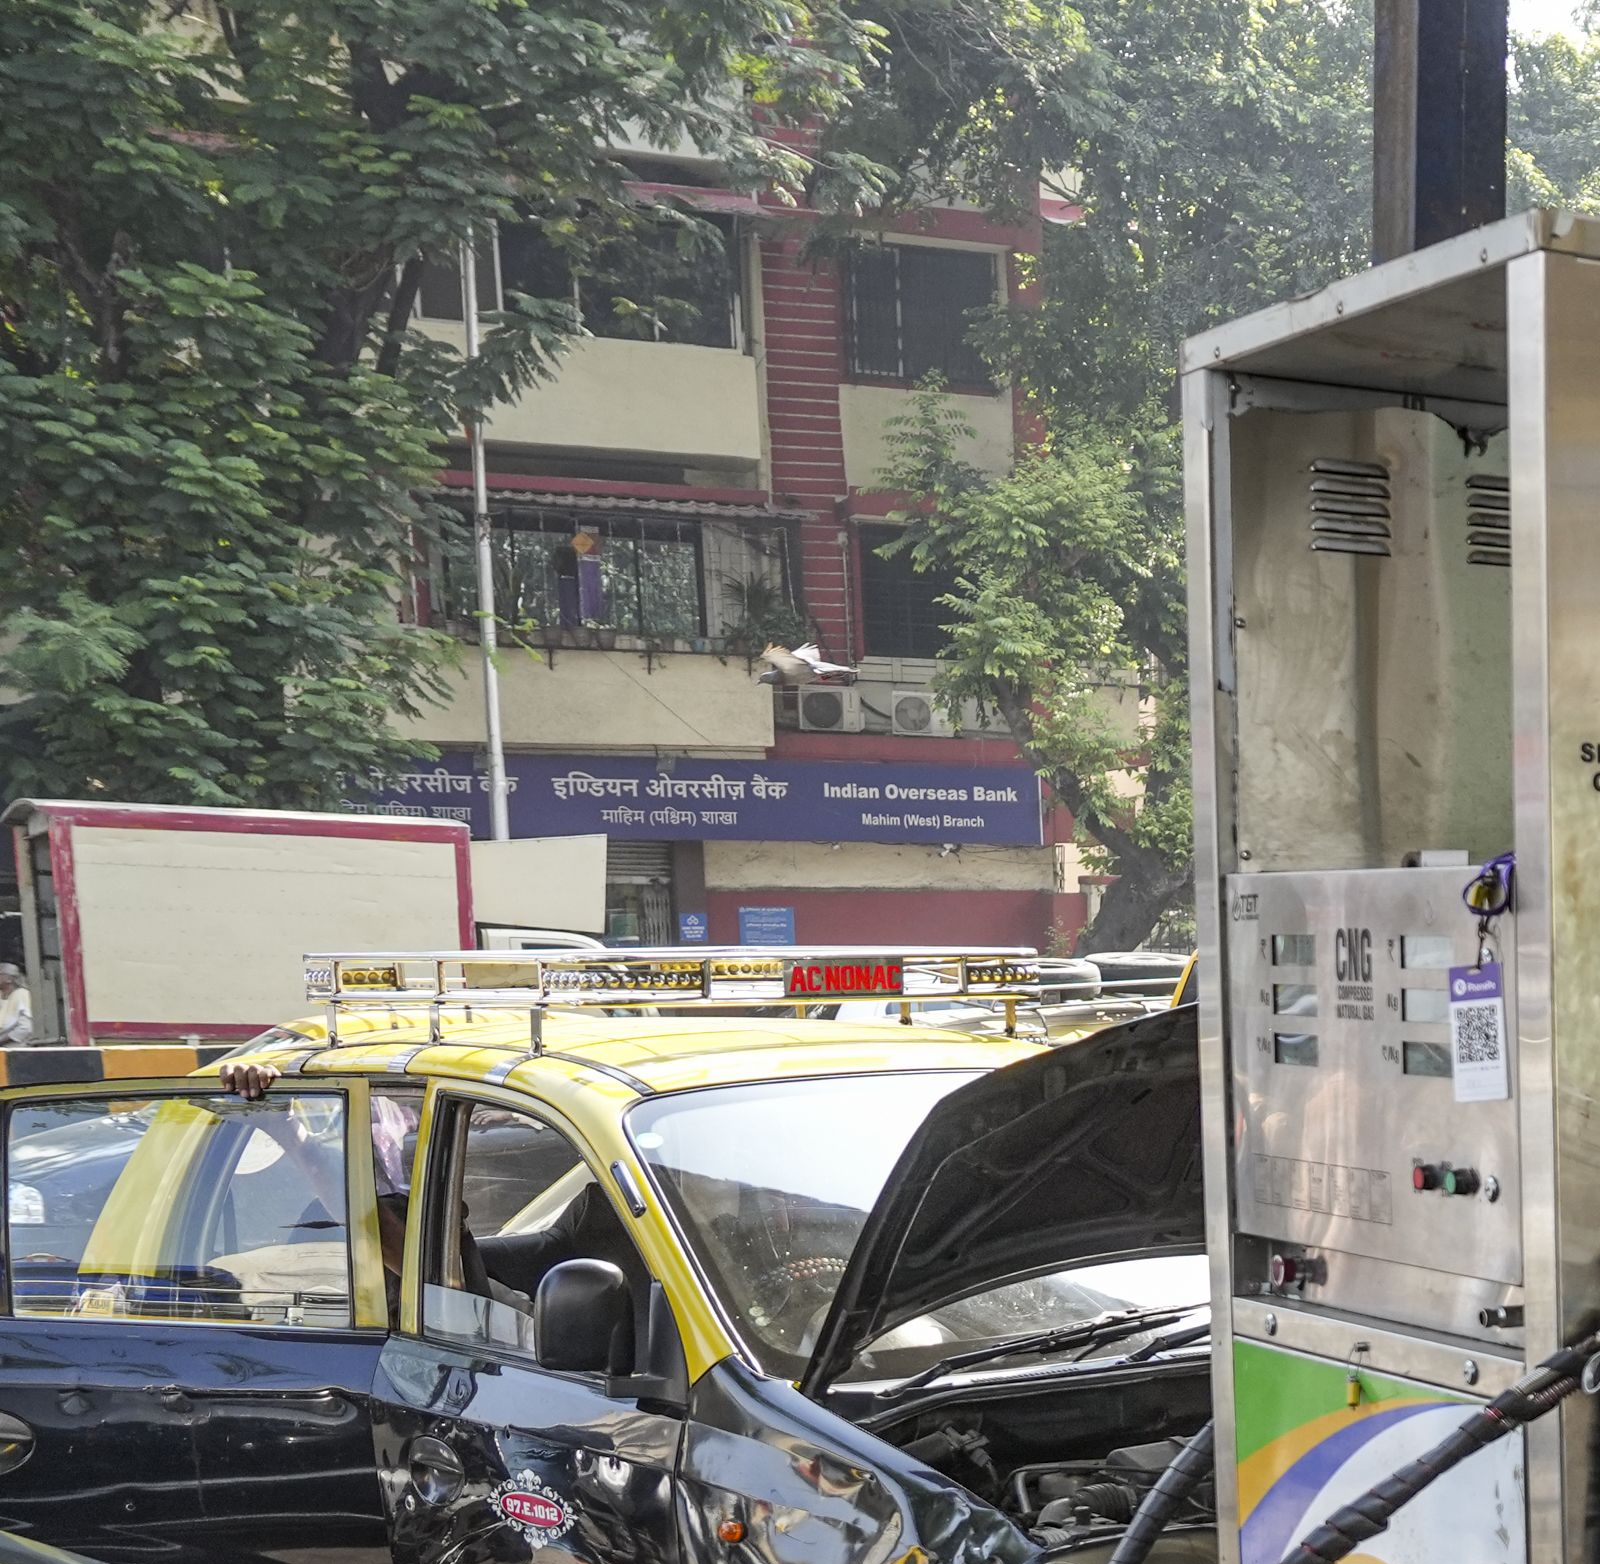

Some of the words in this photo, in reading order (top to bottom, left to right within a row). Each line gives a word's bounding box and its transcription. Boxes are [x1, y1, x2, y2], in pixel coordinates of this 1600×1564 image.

[552, 770, 639, 799] इण्डियन
[750, 773, 789, 800] बैंक
[823, 782, 880, 800] Indian
[884, 783, 969, 802] Overseas
[972, 785, 1019, 803] Bank
[601, 806, 645, 825] माहिम
[701, 810, 738, 826] शाखा
[861, 813, 901, 828] Mahim
[903, 813, 941, 830] (West)
[943, 815, 985, 829] Branch
[1335, 926, 1374, 984] CNG
[505, 1497, 559, 1522] 97.E.1012
